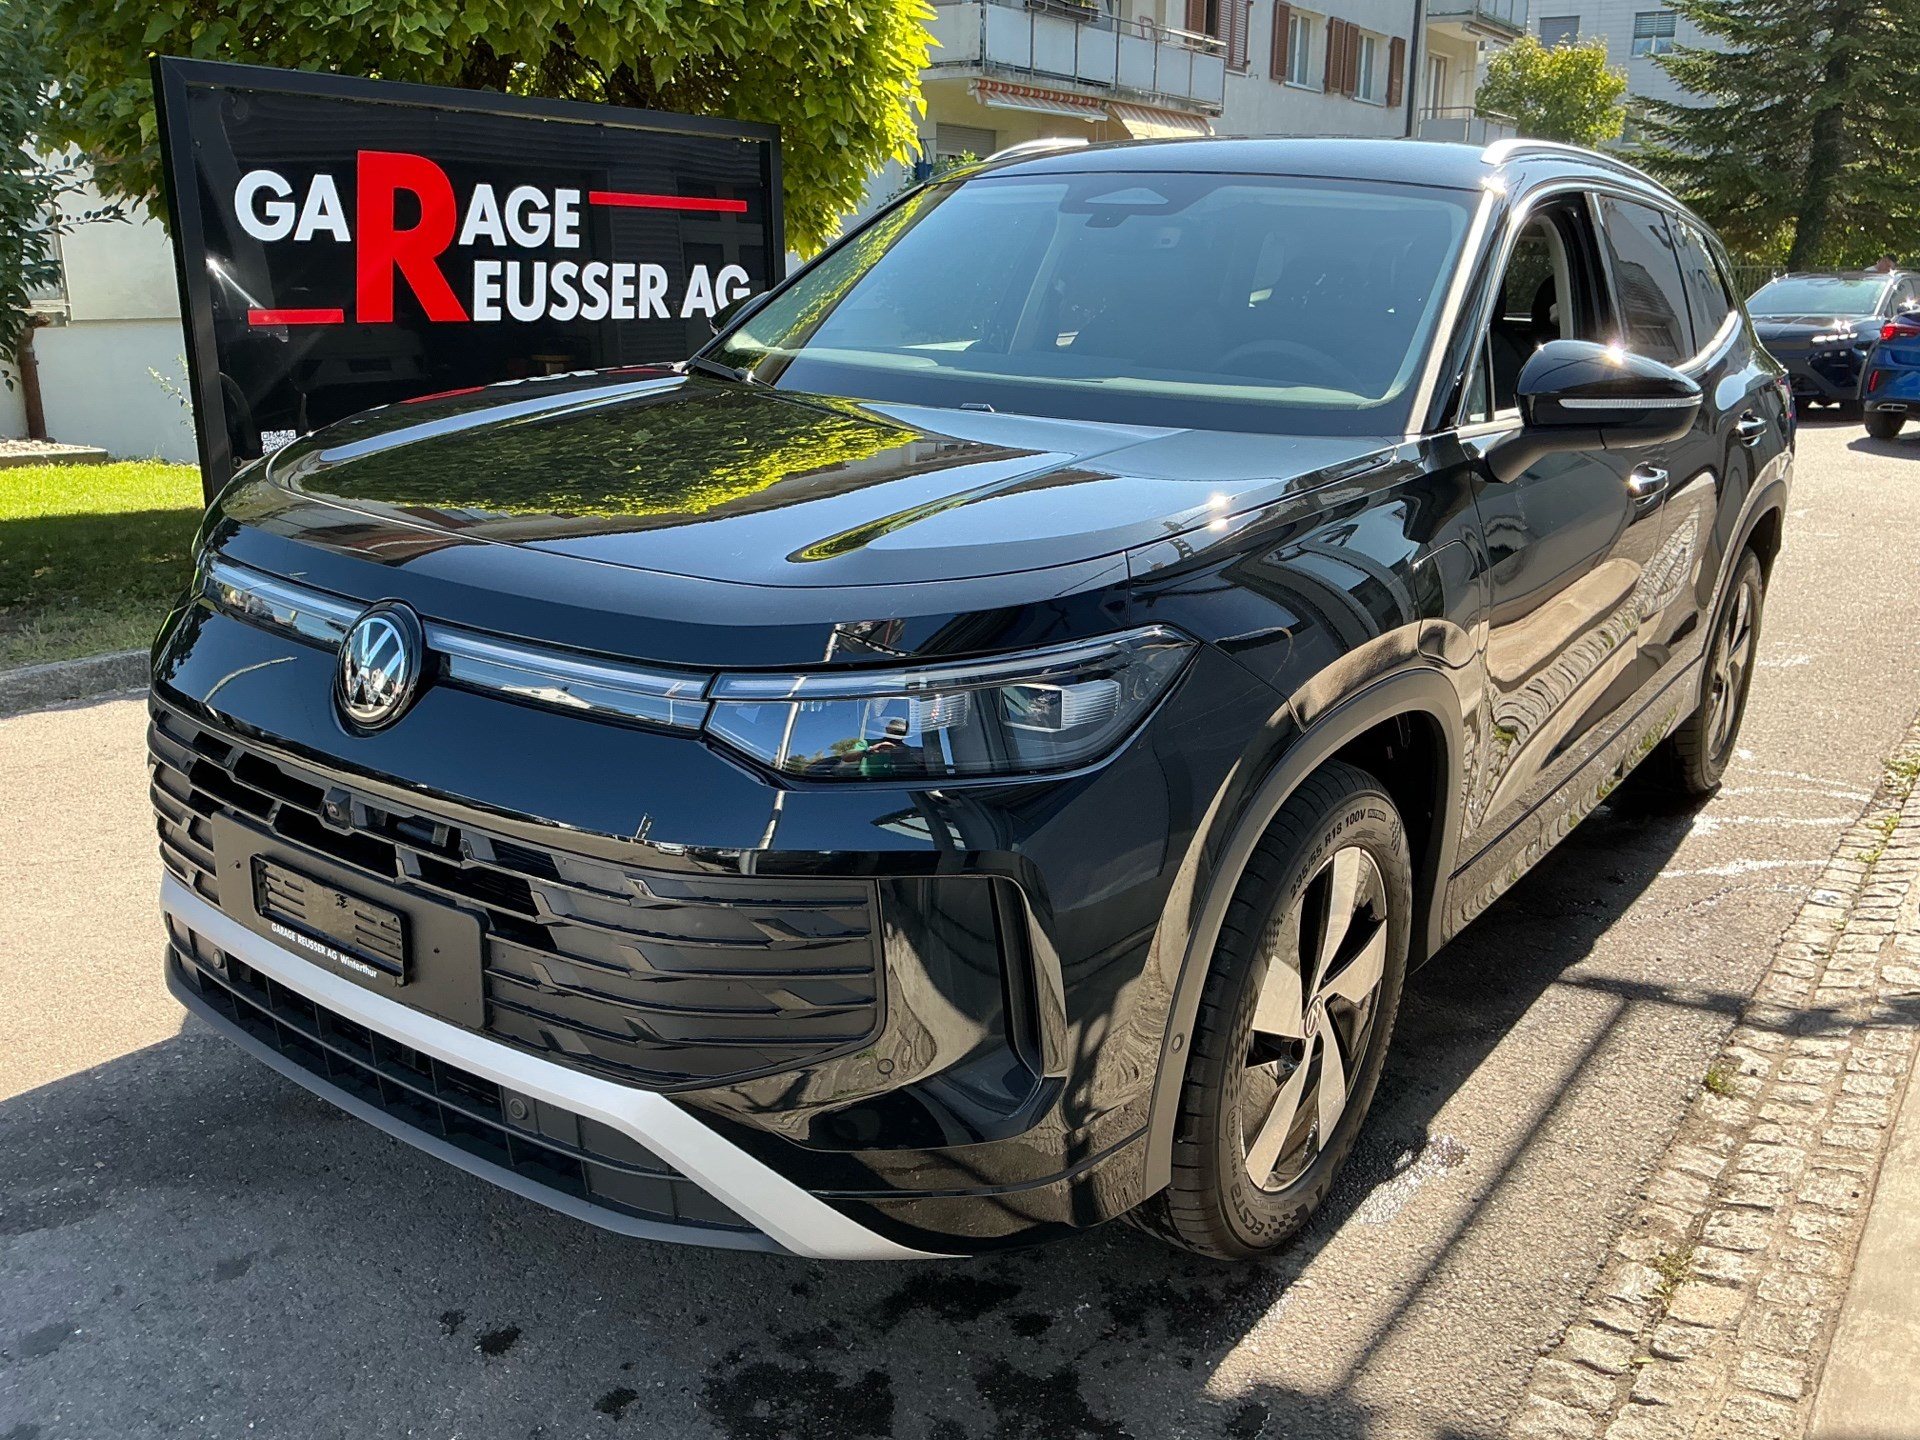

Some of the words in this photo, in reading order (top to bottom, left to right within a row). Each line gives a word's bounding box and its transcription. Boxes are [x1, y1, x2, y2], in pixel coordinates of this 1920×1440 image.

[234, 150, 581, 323] GARAGE
[680, 263, 751, 318] AG
[1290, 844, 1323, 899] 235/55
[1324, 822, 1343, 847] R18
[1345, 808, 1366, 828] 100V
[271, 923, 296, 942] GARAGE
[297, 934, 326, 955] REUSSER
[327, 949, 338, 960] AG
[340, 954, 378, 978] Winterthur
[1230, 1184, 1265, 1236] ECSTA
